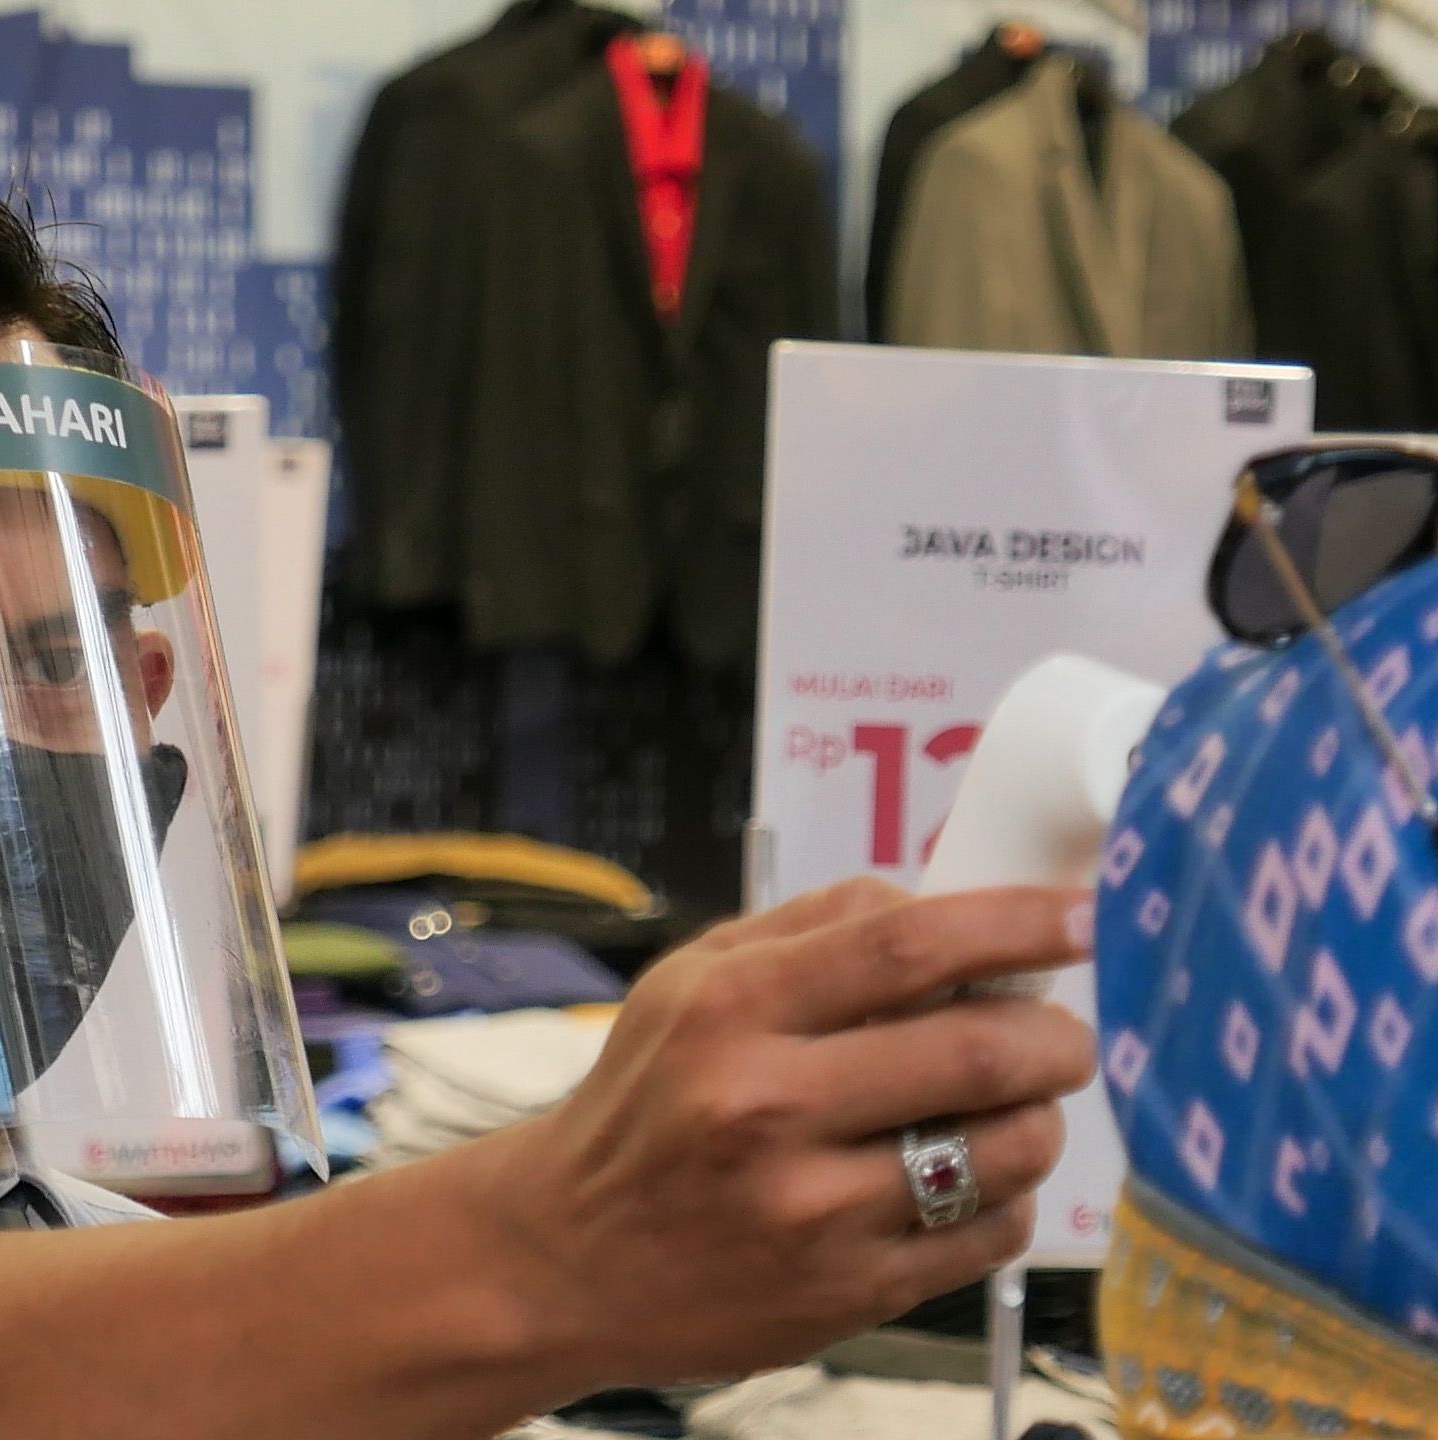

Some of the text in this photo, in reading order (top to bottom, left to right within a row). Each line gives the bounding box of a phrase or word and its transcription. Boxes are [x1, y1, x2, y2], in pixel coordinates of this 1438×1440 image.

[899, 524, 1146, 565] JAVA DESIGN
[785, 726, 847, 775] Rp
